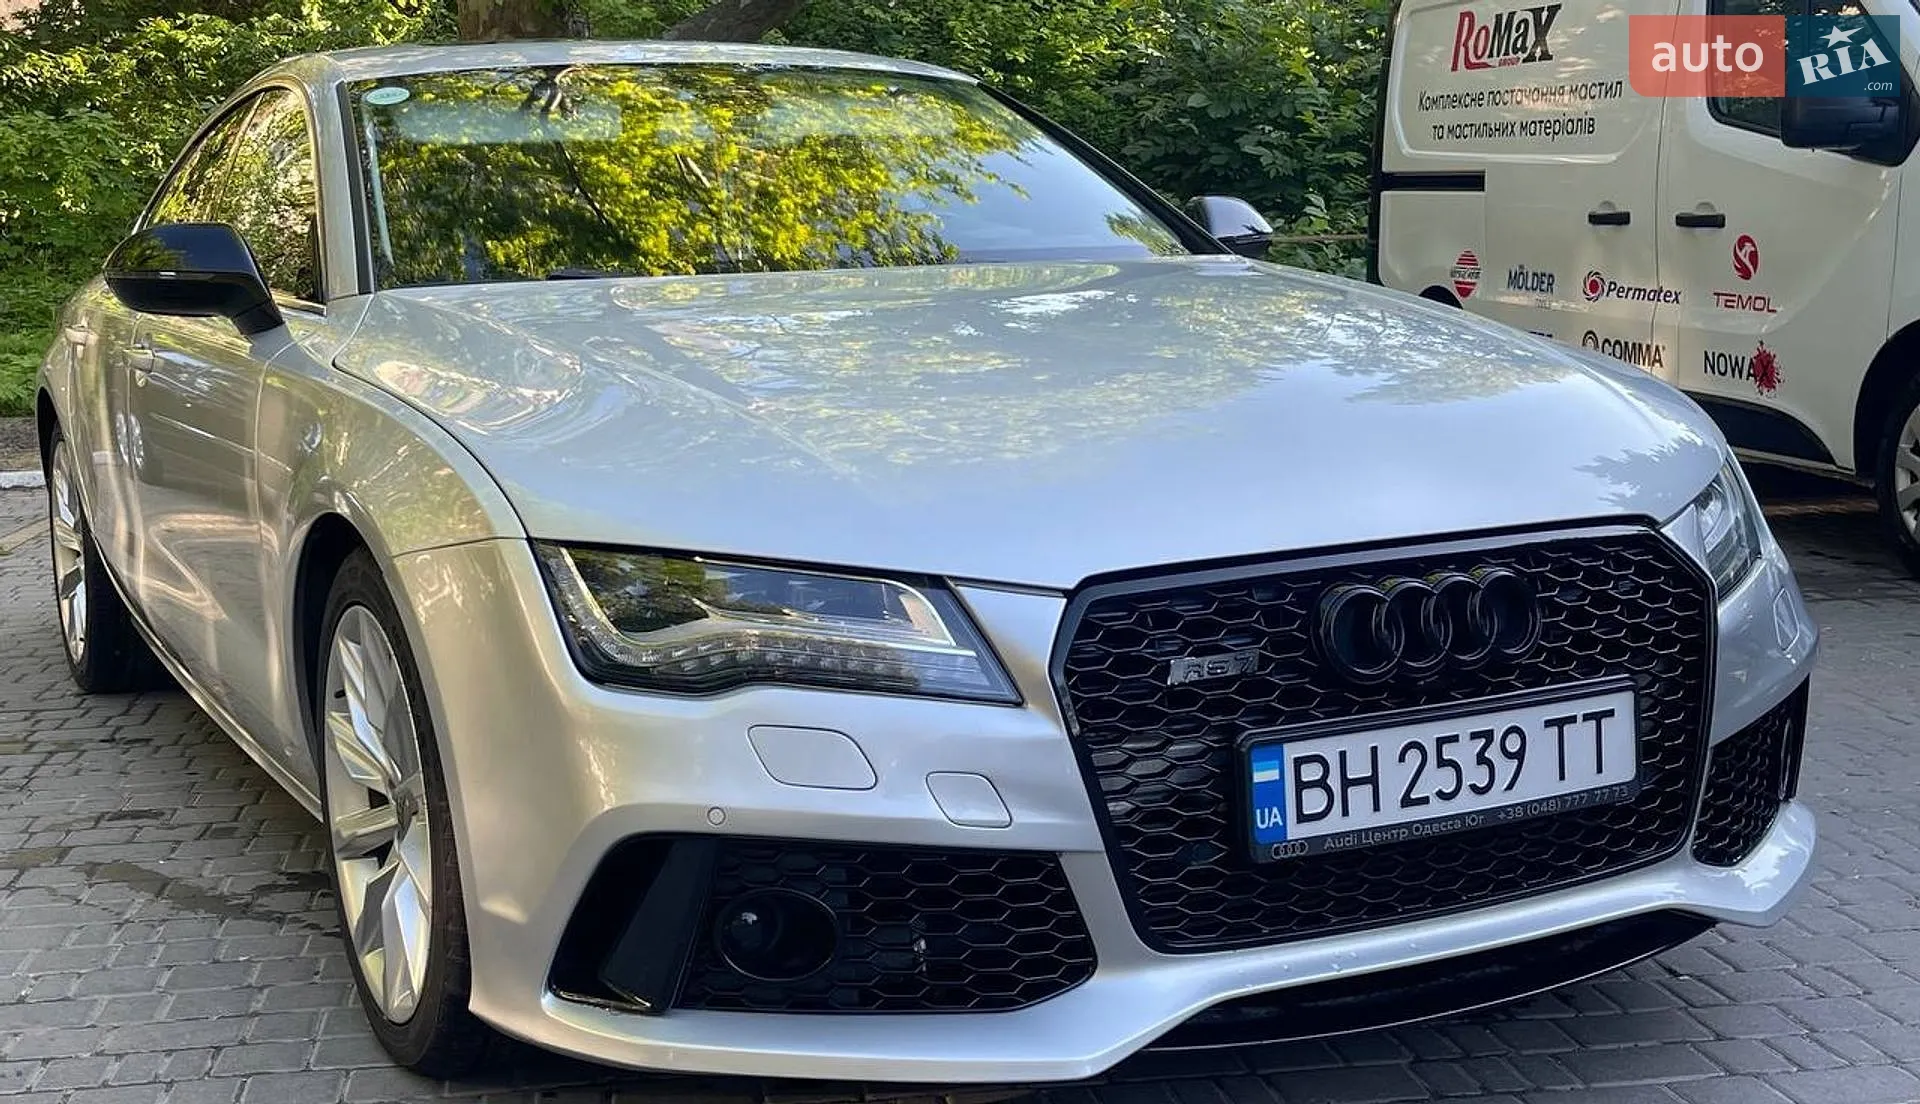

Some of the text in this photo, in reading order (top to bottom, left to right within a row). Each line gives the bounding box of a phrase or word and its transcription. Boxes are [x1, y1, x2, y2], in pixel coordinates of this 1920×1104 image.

[1418, 80, 1623, 111] Комплексне постачання мастил
[1432, 112, 1596, 142] та мастильних матеріалів
[1507, 264, 1556, 295] MÖLDER
[1606, 281, 1683, 304] Permatex
[1713, 291, 1778, 313] TEMOL
[1398, 724, 1527, 809] 2539
[1543, 708, 1616, 781] TT
[1256, 806, 1284, 830] UA
[1324, 833, 1358, 850] Audi
[1361, 828, 1409, 848] Центр
[1412, 817, 1462, 836] Одесса
[1498, 807, 1524, 820] +38
[1527, 800, 1562, 817] (048)
